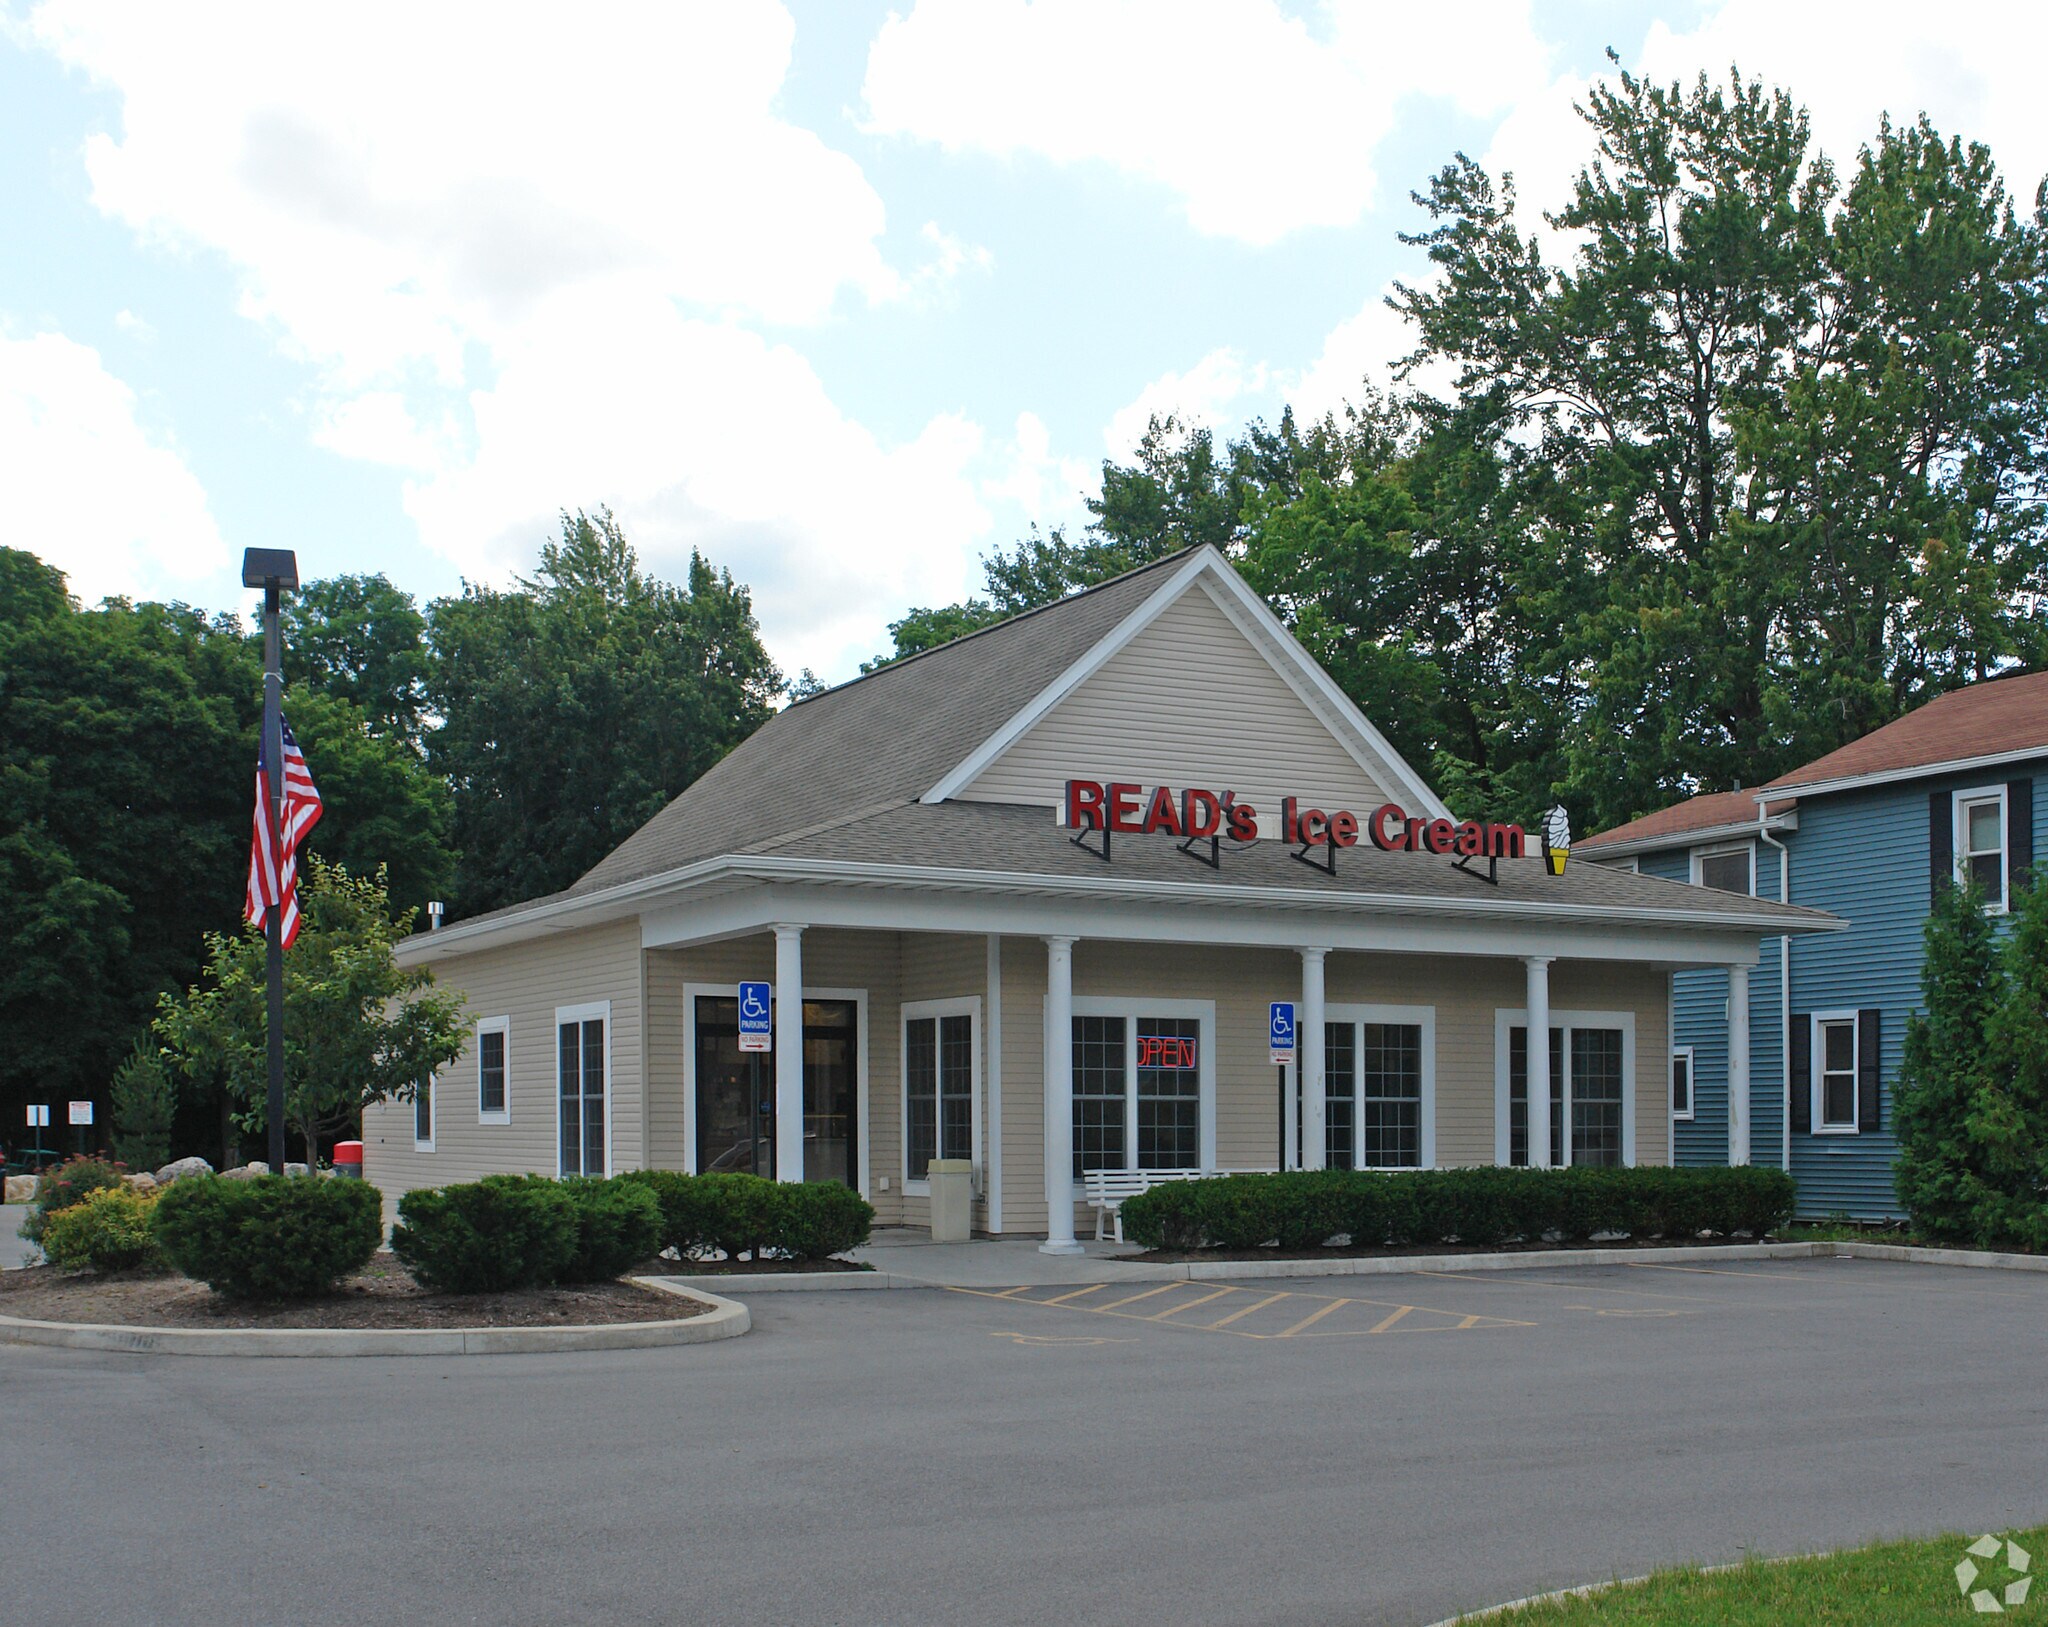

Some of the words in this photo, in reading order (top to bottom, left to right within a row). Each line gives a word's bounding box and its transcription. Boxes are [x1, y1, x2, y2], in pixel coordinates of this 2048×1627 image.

[1065, 780, 1258, 842] READ's
[1282, 797, 1359, 848] Ice
[1369, 803, 1525, 858] Cream
[741, 1020, 769, 1030] PARKING
[1271, 1036, 1293, 1045] PARKING
[1136, 1038, 1195, 1068] OPEN
